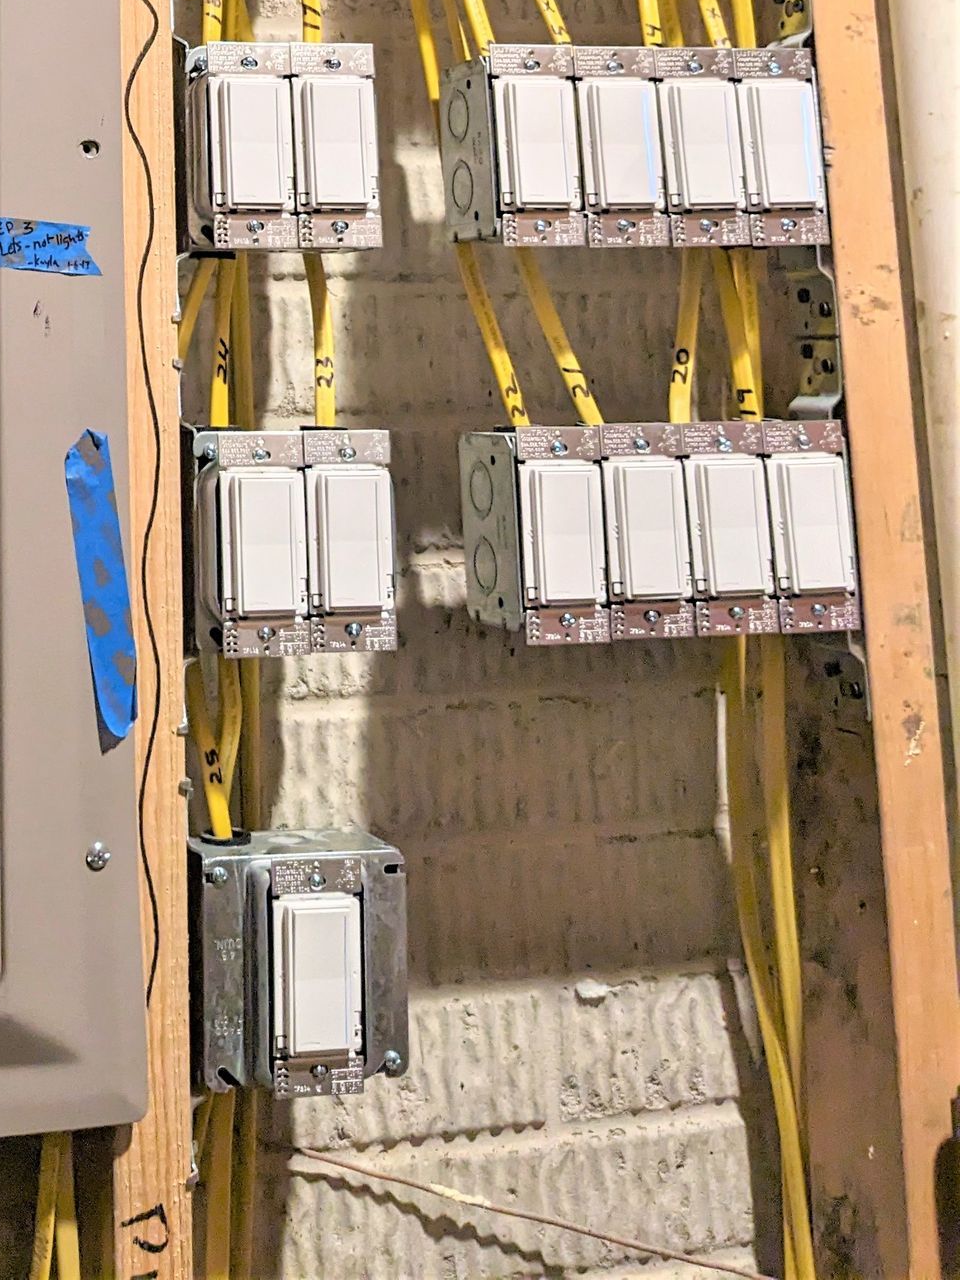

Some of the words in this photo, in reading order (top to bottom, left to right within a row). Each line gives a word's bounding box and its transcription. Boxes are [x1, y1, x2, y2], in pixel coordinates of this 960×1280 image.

[577, 48, 613, 56] LUTRON
[23, 223, 34, 235] 3
[216, 337, 230, 385] 24
[316, 356, 334, 389] 23
[671, 347, 690, 385] 20
[504, 373, 527, 418] 22
[561, 366, 592, 399] 21
[736, 387, 757, 417] 19
[204, 747, 224, 785] 25
